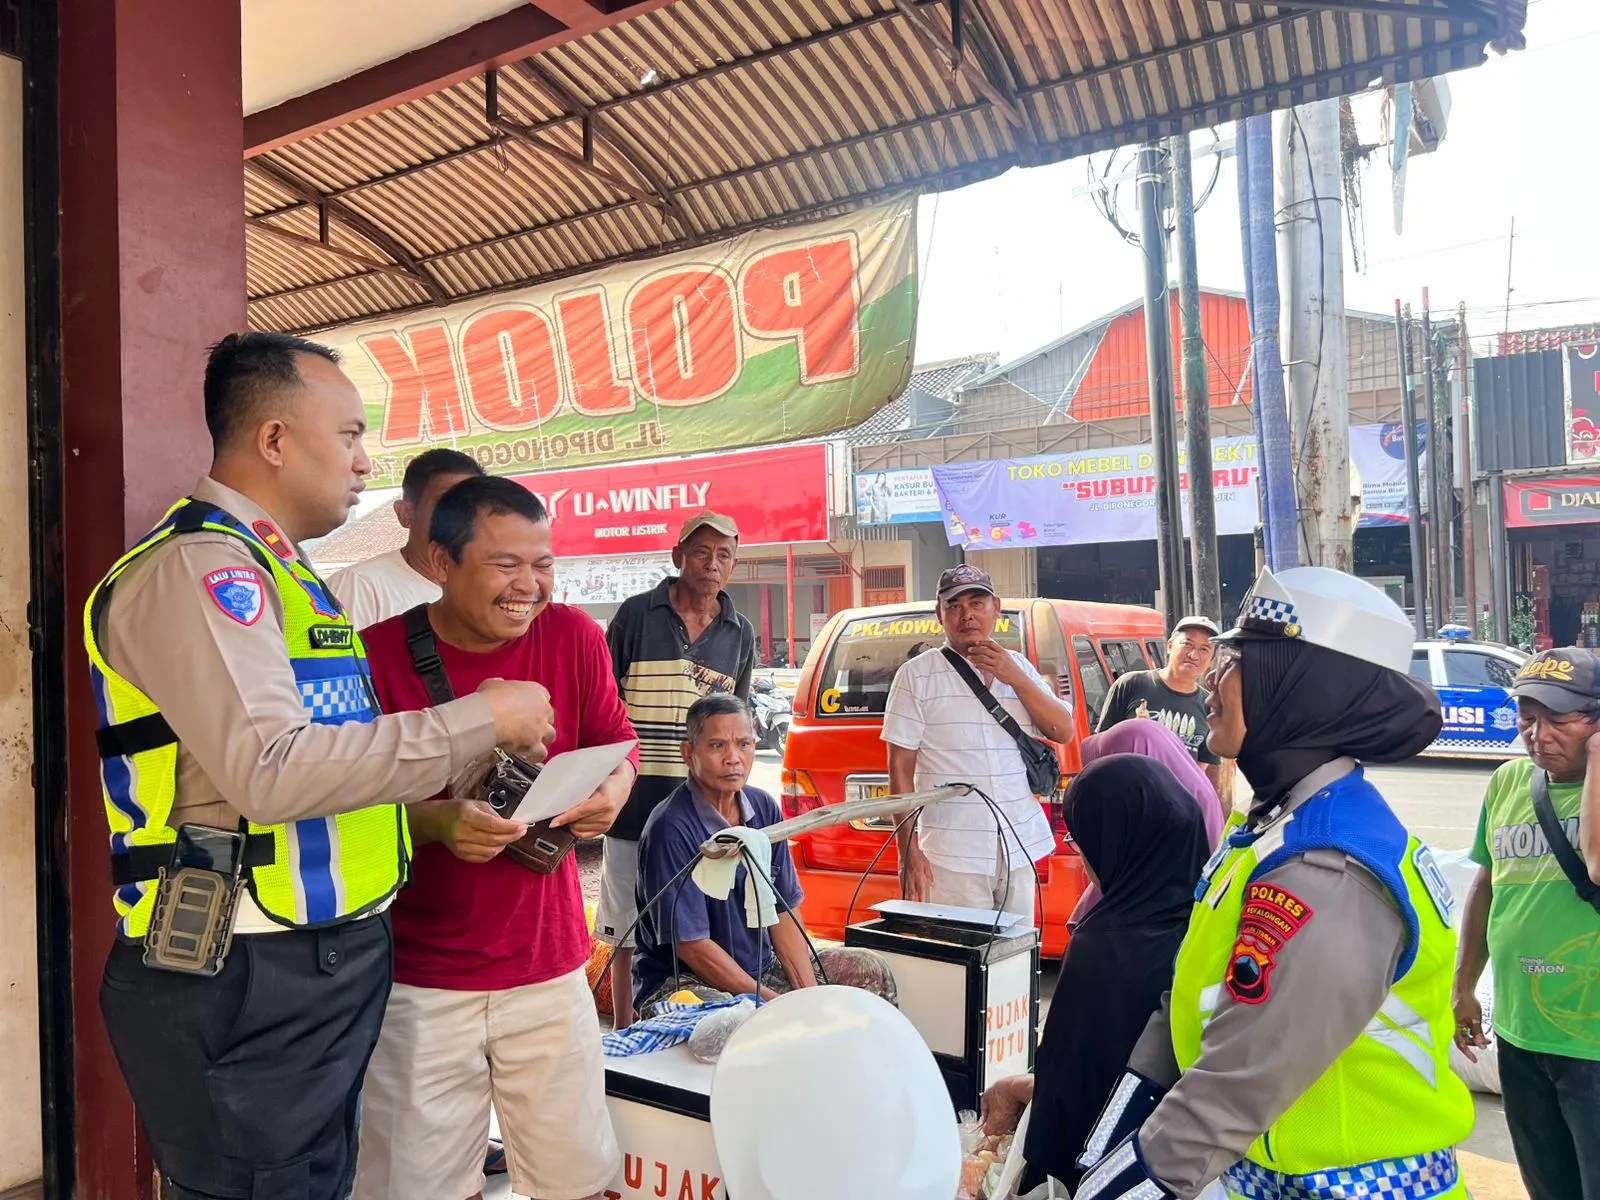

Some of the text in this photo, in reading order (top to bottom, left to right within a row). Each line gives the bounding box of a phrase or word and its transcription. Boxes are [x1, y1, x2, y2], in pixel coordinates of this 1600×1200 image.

[1008, 461, 1063, 480] TOKO
[1068, 453, 1133, 476] MEBEL
[894, 481, 921, 491] KASUR
[894, 489, 925, 498] BAKTERI
[1103, 500, 1156, 511] DIPONEGOR
[988, 513, 1008, 521] KUR
[594, 523, 669, 539] MOTOR LISTRIK
[208, 570, 256, 584] LALU LINTAS
[820, 688, 841, 713] C
[1250, 886, 1304, 917] POLRES
[1522, 965, 1565, 974] LEMON
[986, 992, 1028, 1031] RUJAK
[988, 1028, 1025, 1064] TUTU
[624, 1152, 721, 1200] UJAK
